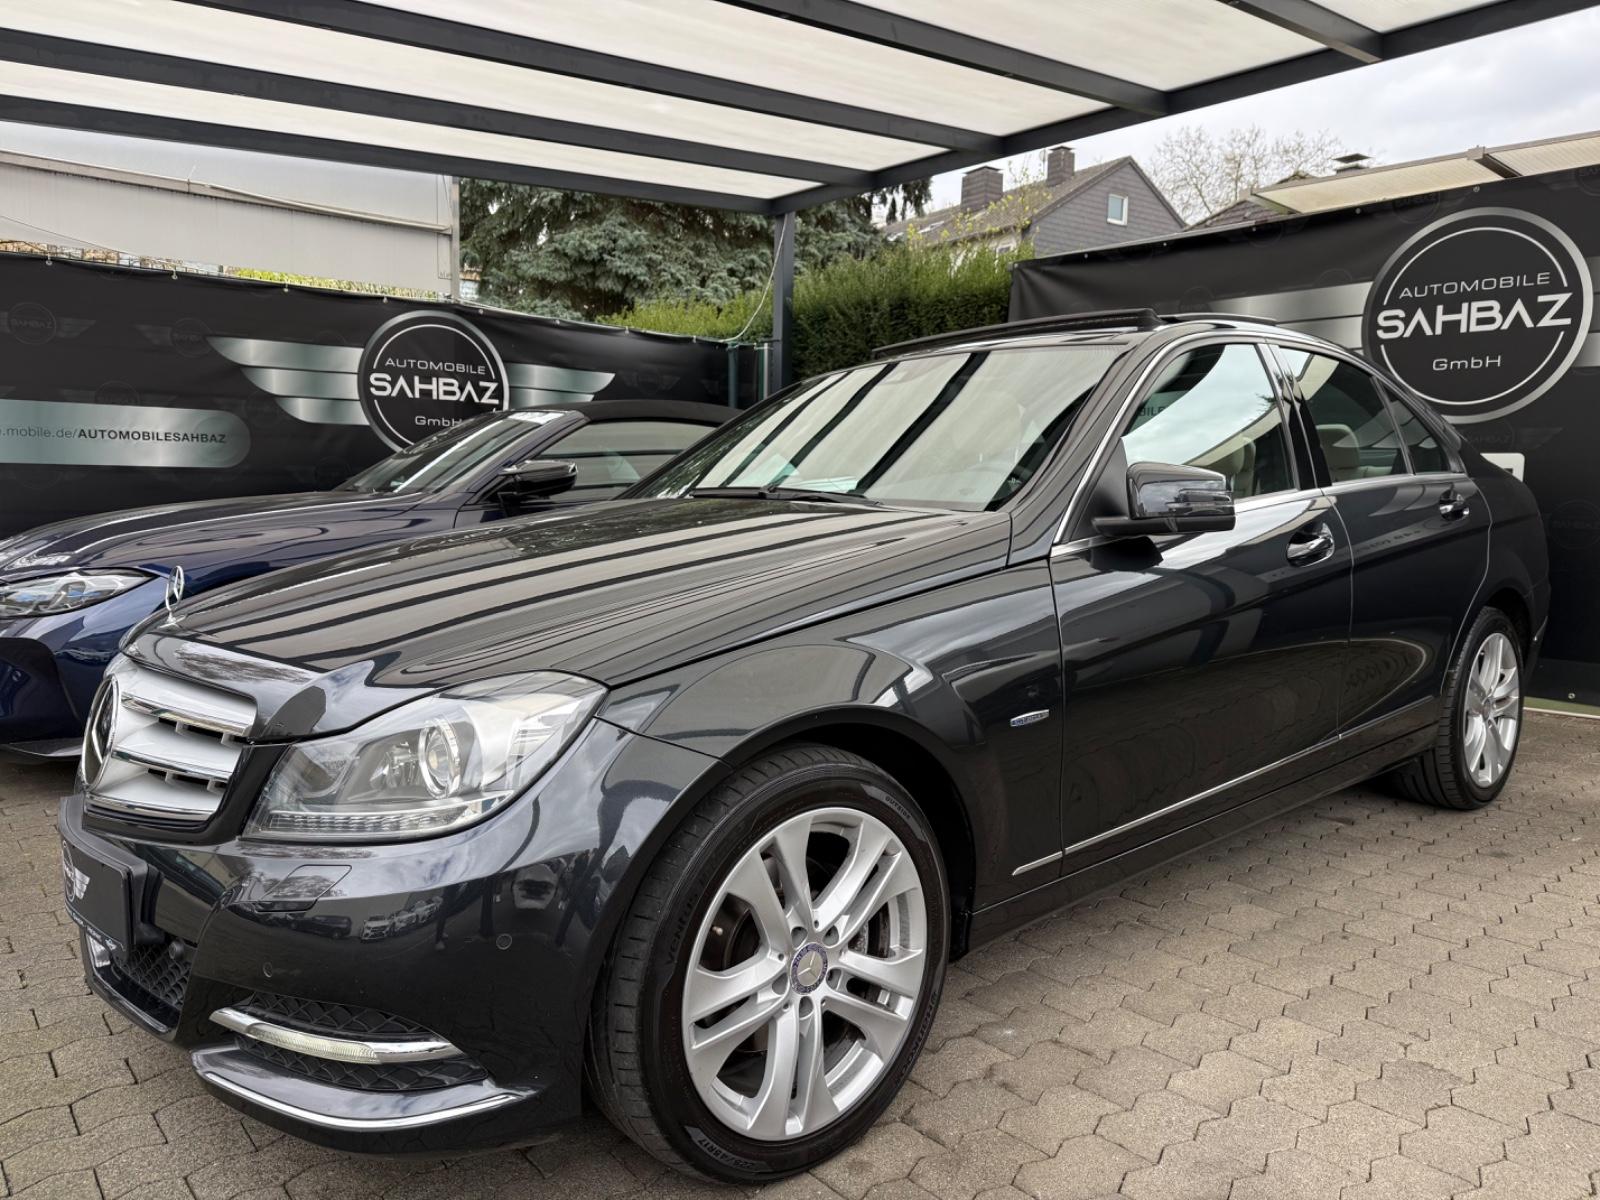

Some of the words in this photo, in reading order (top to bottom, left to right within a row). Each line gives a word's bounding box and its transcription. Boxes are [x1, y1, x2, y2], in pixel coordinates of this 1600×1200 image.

[1398, 271, 1551, 300] AUTOMOBILE
[1376, 292, 1573, 340] SAHBAZ
[384, 357, 487, 375] AUTOMOBILE
[1432, 355, 1502, 371] GmbH
[369, 372, 500, 405] SAHBAZ
[0, 426, 226, 443] .mobile.de/AUTOMOBILESAHBAZ
